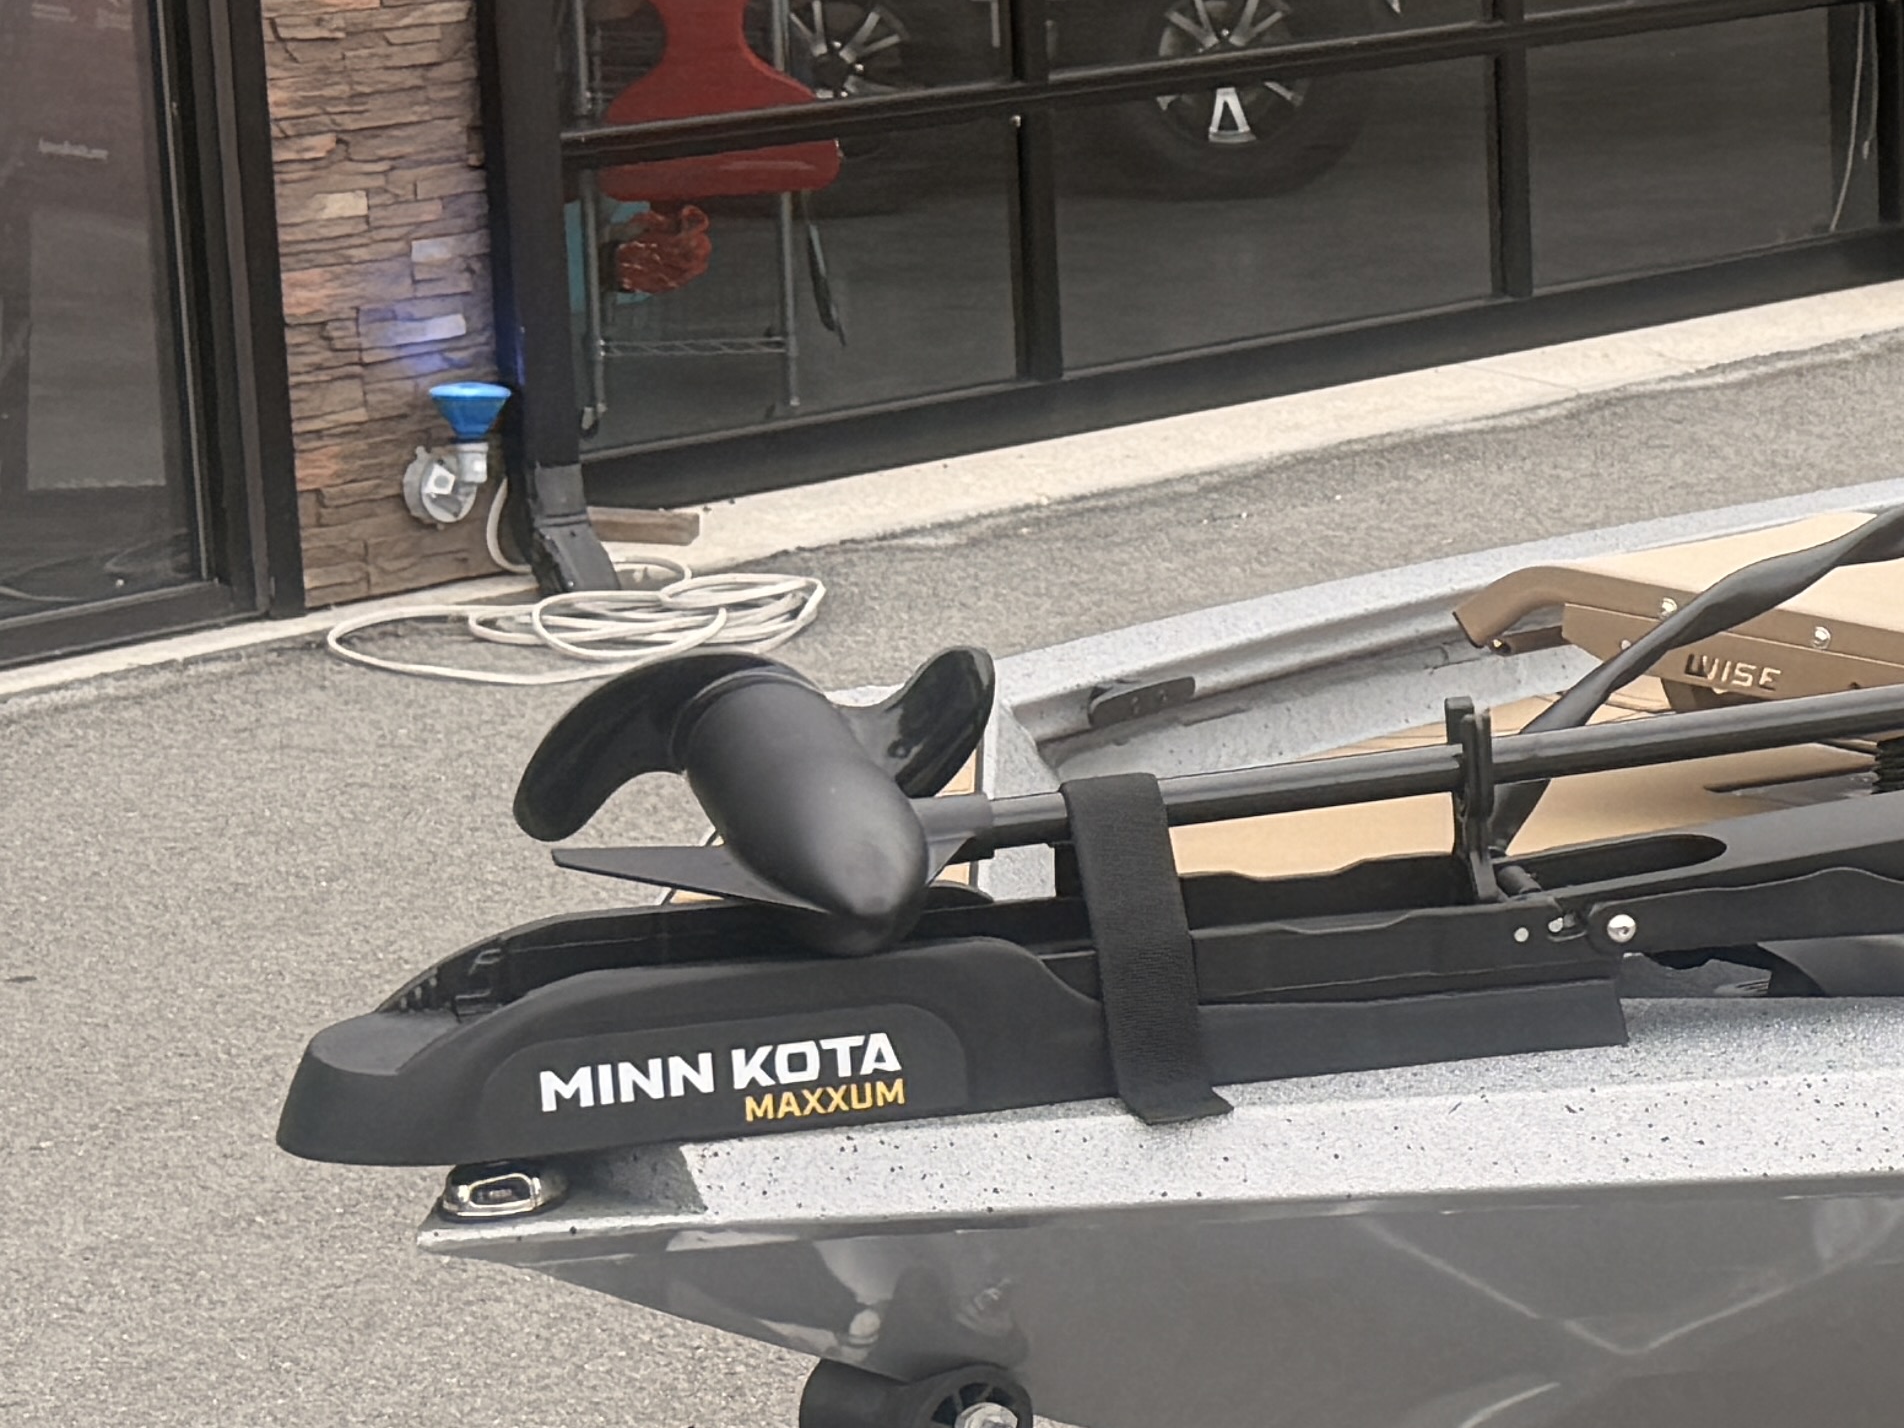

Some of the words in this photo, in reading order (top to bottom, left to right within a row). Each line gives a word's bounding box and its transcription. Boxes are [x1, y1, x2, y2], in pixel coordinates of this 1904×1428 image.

[1683, 653, 1782, 691] WISE
[539, 1052, 715, 1113] MINN
[731, 1032, 903, 1091] KOTA
[744, 1078, 906, 1123] MAXXUM
